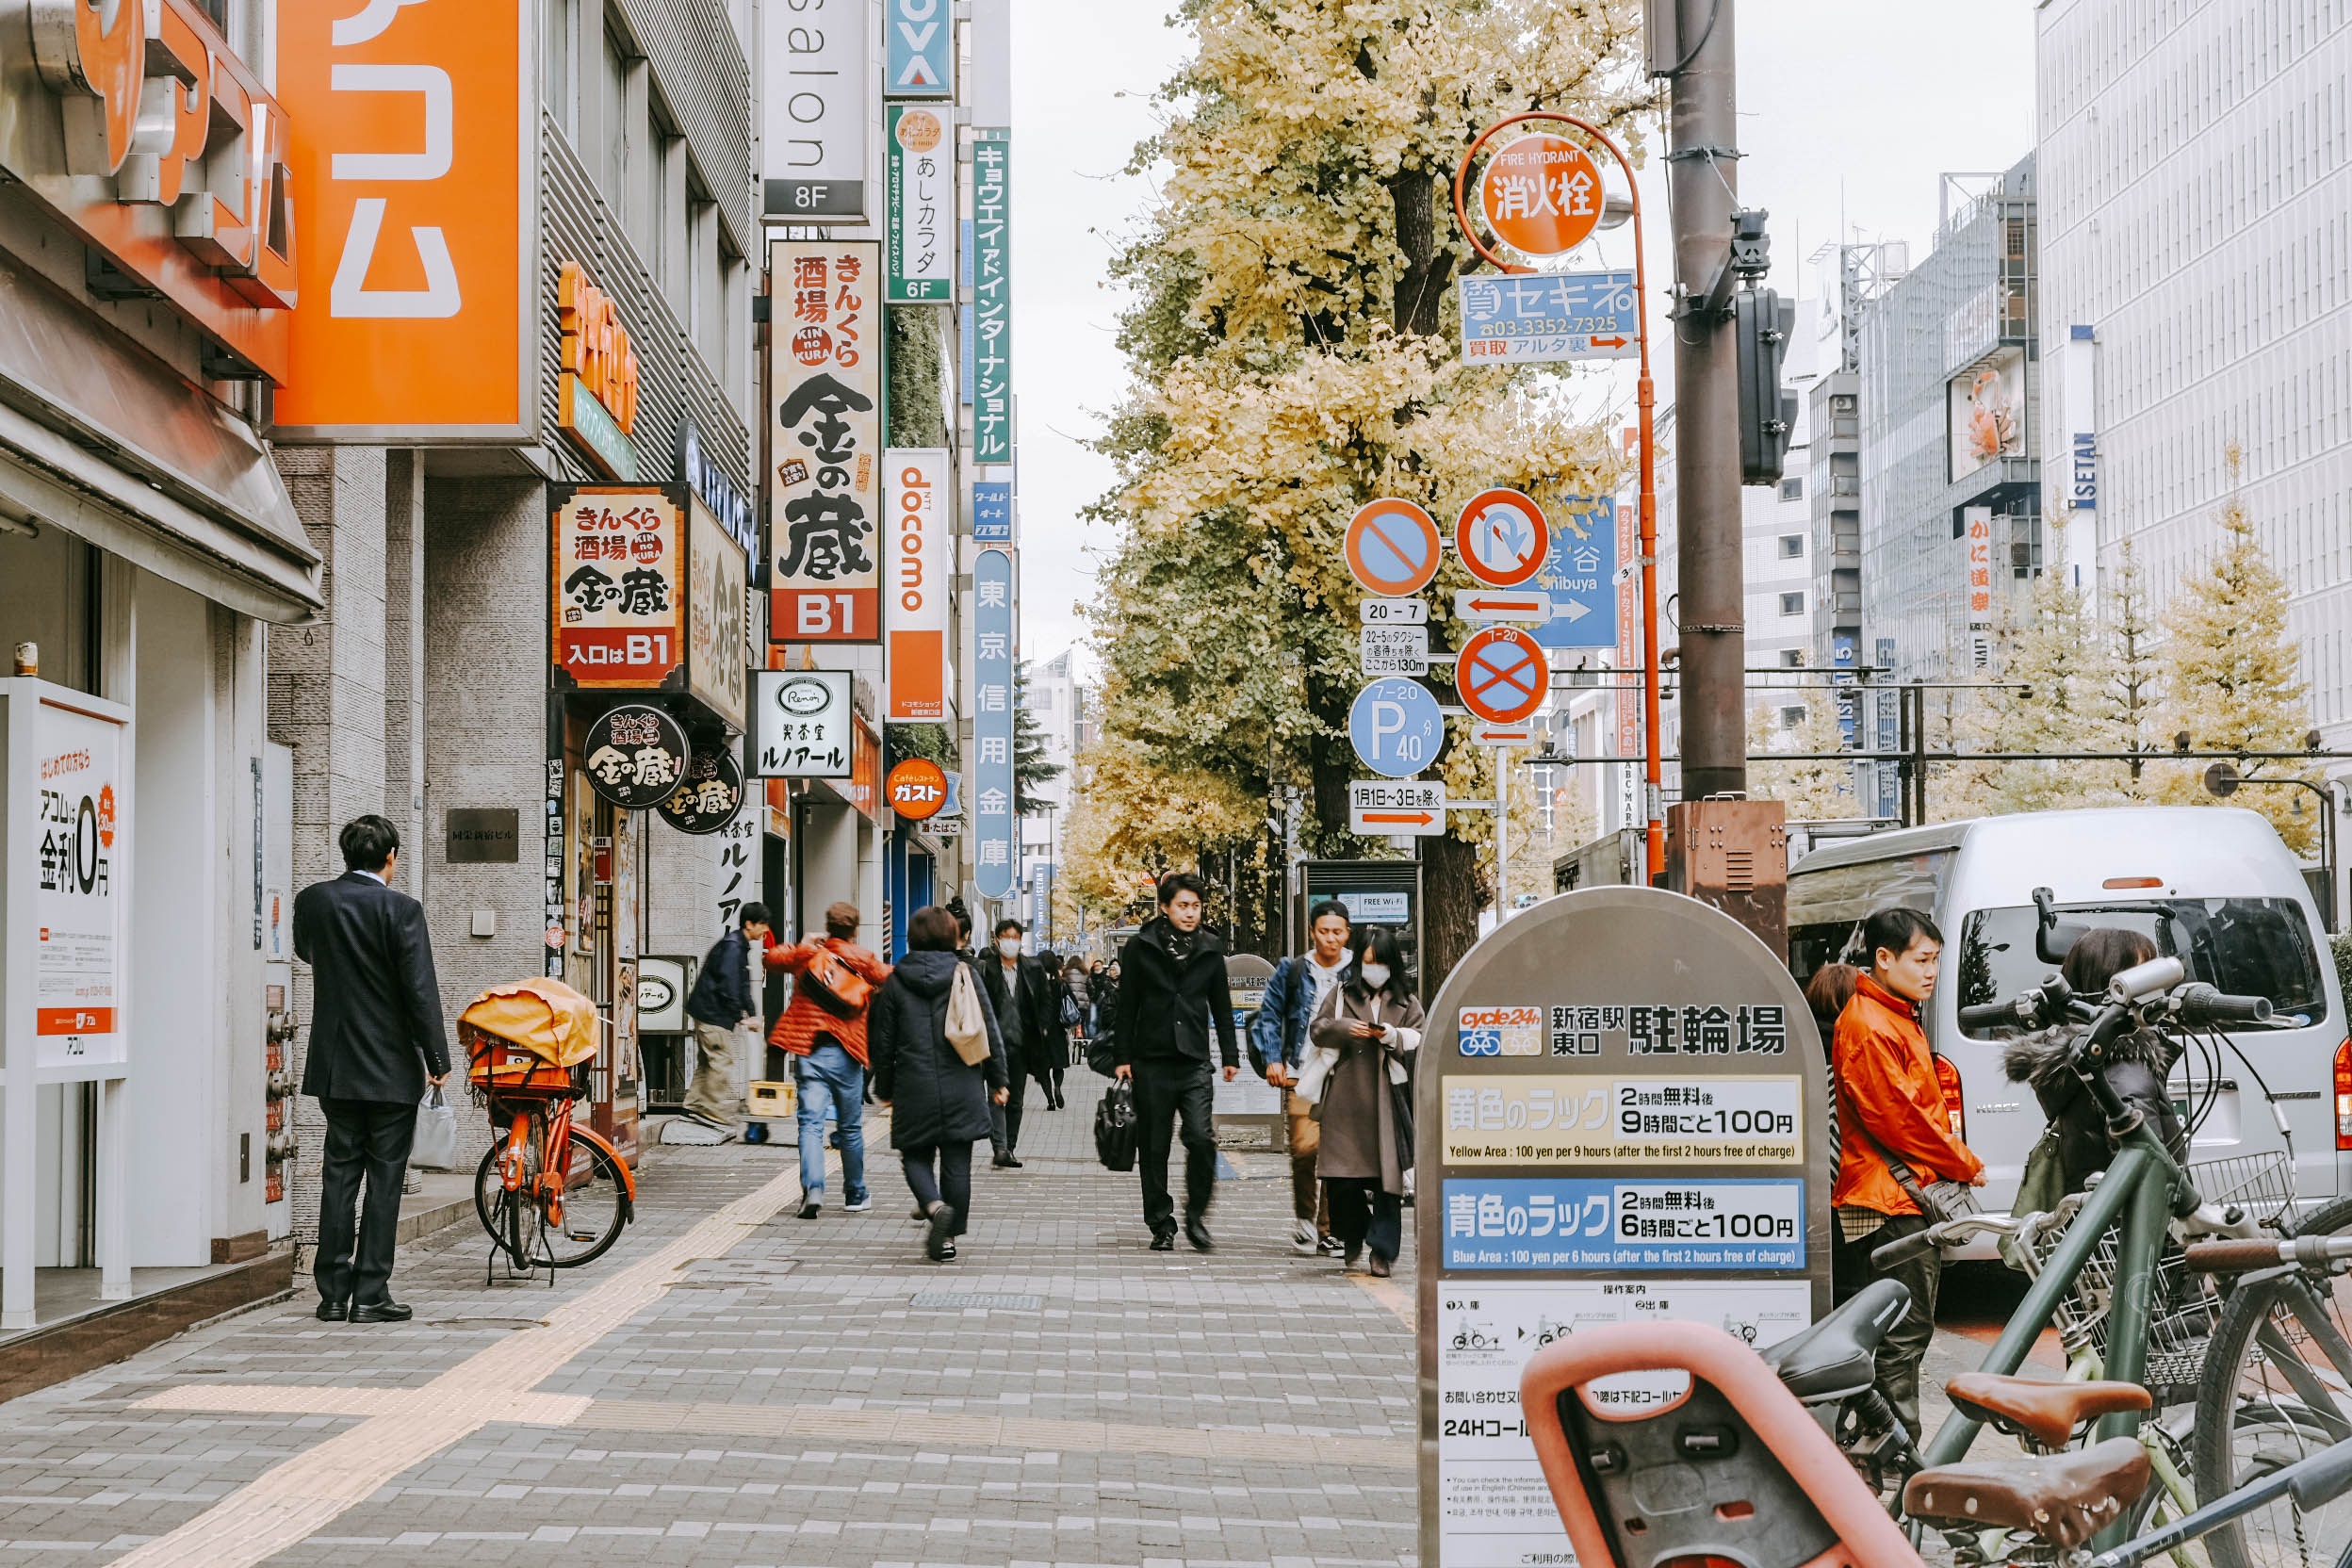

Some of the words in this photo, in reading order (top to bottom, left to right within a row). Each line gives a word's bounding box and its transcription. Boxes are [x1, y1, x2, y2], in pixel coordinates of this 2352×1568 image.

[1500, 154, 1525, 166] FIRE
[1528, 151, 1580, 165] HYDRANT
[794, 186, 827, 207] 8F
[1493, 171, 1594, 220] 消火栓
[917, 156, 936, 273] あしカラダ
[792, 255, 828, 323] 酒場
[906, 282, 931, 298] 6F
[1464, 281, 1500, 320] 質
[835, 253, 862, 368] きんくら
[796, 327, 823, 340] KIN
[1494, 317, 1618, 336] 03-3352-7325
[794, 349, 830, 362] KURA
[803, 339, 821, 349] no
[1469, 340, 1507, 357] 買取
[1513, 336, 1587, 354] アルタ裏
[778, 372, 874, 580] 金の蔵
[923, 491, 932, 512] NTT
[575, 506, 662, 531] きんくら
[574, 534, 628, 561] 酒場
[635, 532, 655, 544] KIN
[901, 466, 931, 612] docomo
[633, 550, 662, 562] KURA
[564, 564, 669, 615] 金の蔵
[797, 594, 855, 635] B1
[1487, 629, 1518, 643] 7-20
[1375, 685, 1418, 700] 7-20
[978, 580, 1008, 867] 東京信用金庫
[1372, 700, 1406, 760] P
[762, 746, 844, 770] ルノアール
[1396, 734, 1422, 762] 40
[588, 745, 674, 786] 金の蔵
[894, 785, 942, 802] ガスト
[41, 789, 75, 825] アコムは
[1553, 1006, 1625, 1030] 新宿駅
[1628, 1005, 1787, 1055] 駐輪場
[1553, 1033, 1600, 1056] 東口
[1621, 1086, 1713, 1106] 2時間無料後
[1449, 1087, 1609, 1131] 黄色のラック
[1621, 1110, 1793, 1134] 9時間ごと100円
[1449, 1145, 1481, 1157] Yellow
[1484, 1145, 1507, 1157] Area
[1516, 1145, 1533, 1157] 100
[1536, 1145, 1553, 1159] yen
[1556, 1145, 1572, 1159] per
[1575, 1145, 1580, 1157] 9
[1583, 1145, 1611, 1157] hours
[1613, 1145, 1641, 1159] (after
[1644, 1145, 1659, 1157] the
[1662, 1145, 1682, 1157] first
[1685, 1145, 1691, 1157] 2
[1693, 1145, 1722, 1157] hours
[1723, 1145, 1743, 1157] free
[1745, 1145, 1756, 1157] of
[1757, 1145, 1795, 1159] charge)
[1622, 1191, 1715, 1211] 2時間無料後
[1448, 1194, 1609, 1237] 青色のラック
[1621, 1214, 1793, 1237] 6時間ごと100円
[1453, 1250, 1476, 1263] Blue
[1478, 1250, 1502, 1263] Area
[1511, 1250, 1529, 1263] 100
[1532, 1250, 1550, 1265] yen
[1553, 1250, 1570, 1265] per
[1572, 1250, 1578, 1263] 6
[1581, 1250, 1610, 1263] hours
[1612, 1250, 1641, 1265] (after
[1643, 1250, 1659, 1263] the
[1662, 1250, 1682, 1263] first
[1685, 1250, 1691, 1263] 2
[1693, 1250, 1722, 1263] hours
[1723, 1250, 1743, 1263] free
[1745, 1250, 1756, 1263] of
[1757, 1250, 1795, 1265] charge)
[1604, 1284, 1646, 1295] 操作案内
[1445, 1391, 1520, 1404] お問い合わせ又
[1481, 1484, 1506, 1493] English
[1521, 1554, 1578, 1565] ご利用の際
